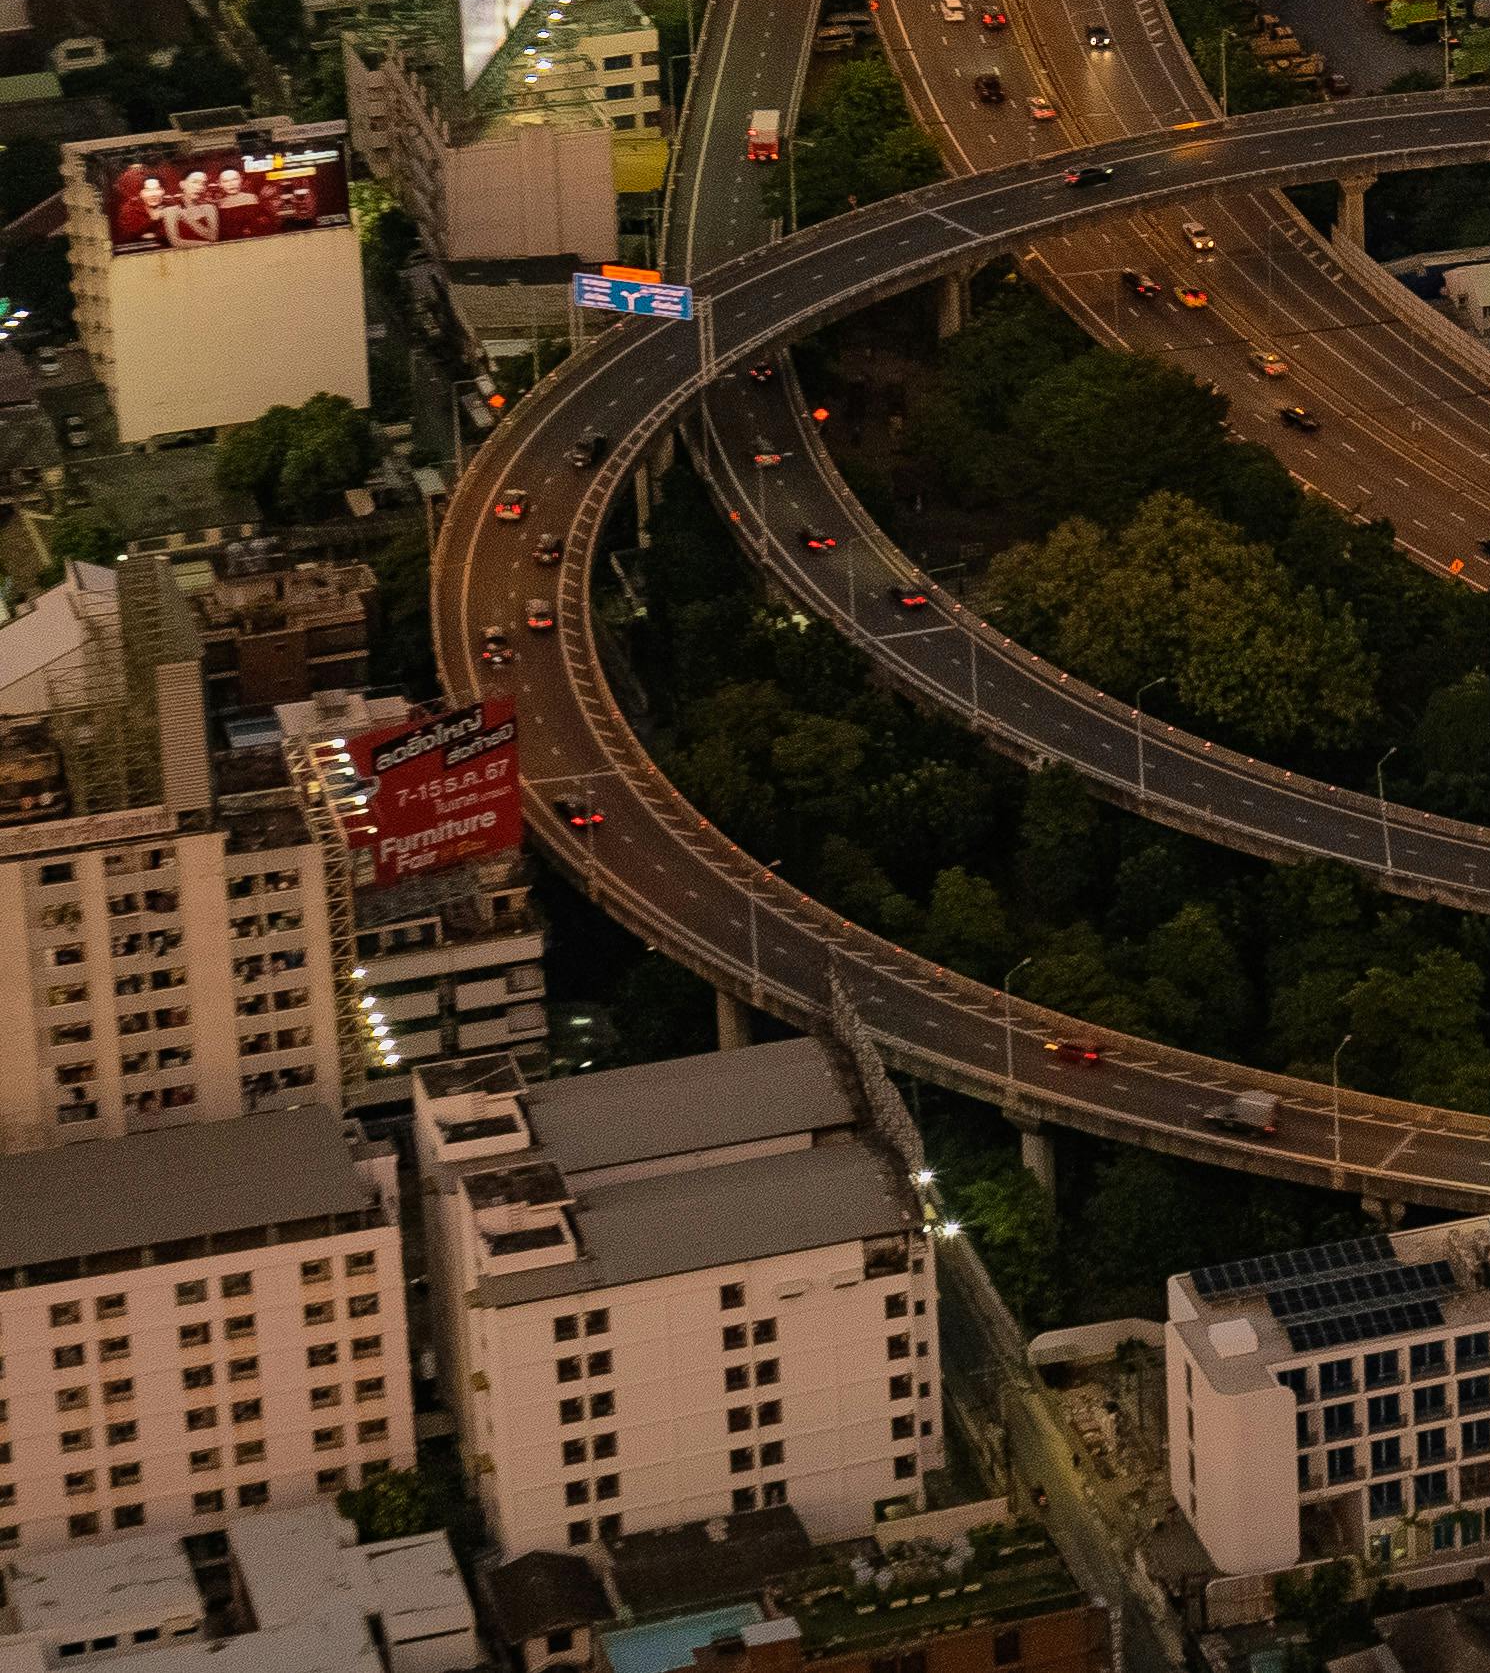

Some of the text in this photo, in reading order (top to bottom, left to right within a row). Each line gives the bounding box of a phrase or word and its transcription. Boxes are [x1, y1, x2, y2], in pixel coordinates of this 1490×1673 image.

[485, 758, 510, 780] 67
[380, 811, 497, 863] Furniture
[397, 848, 437, 873] Fair
